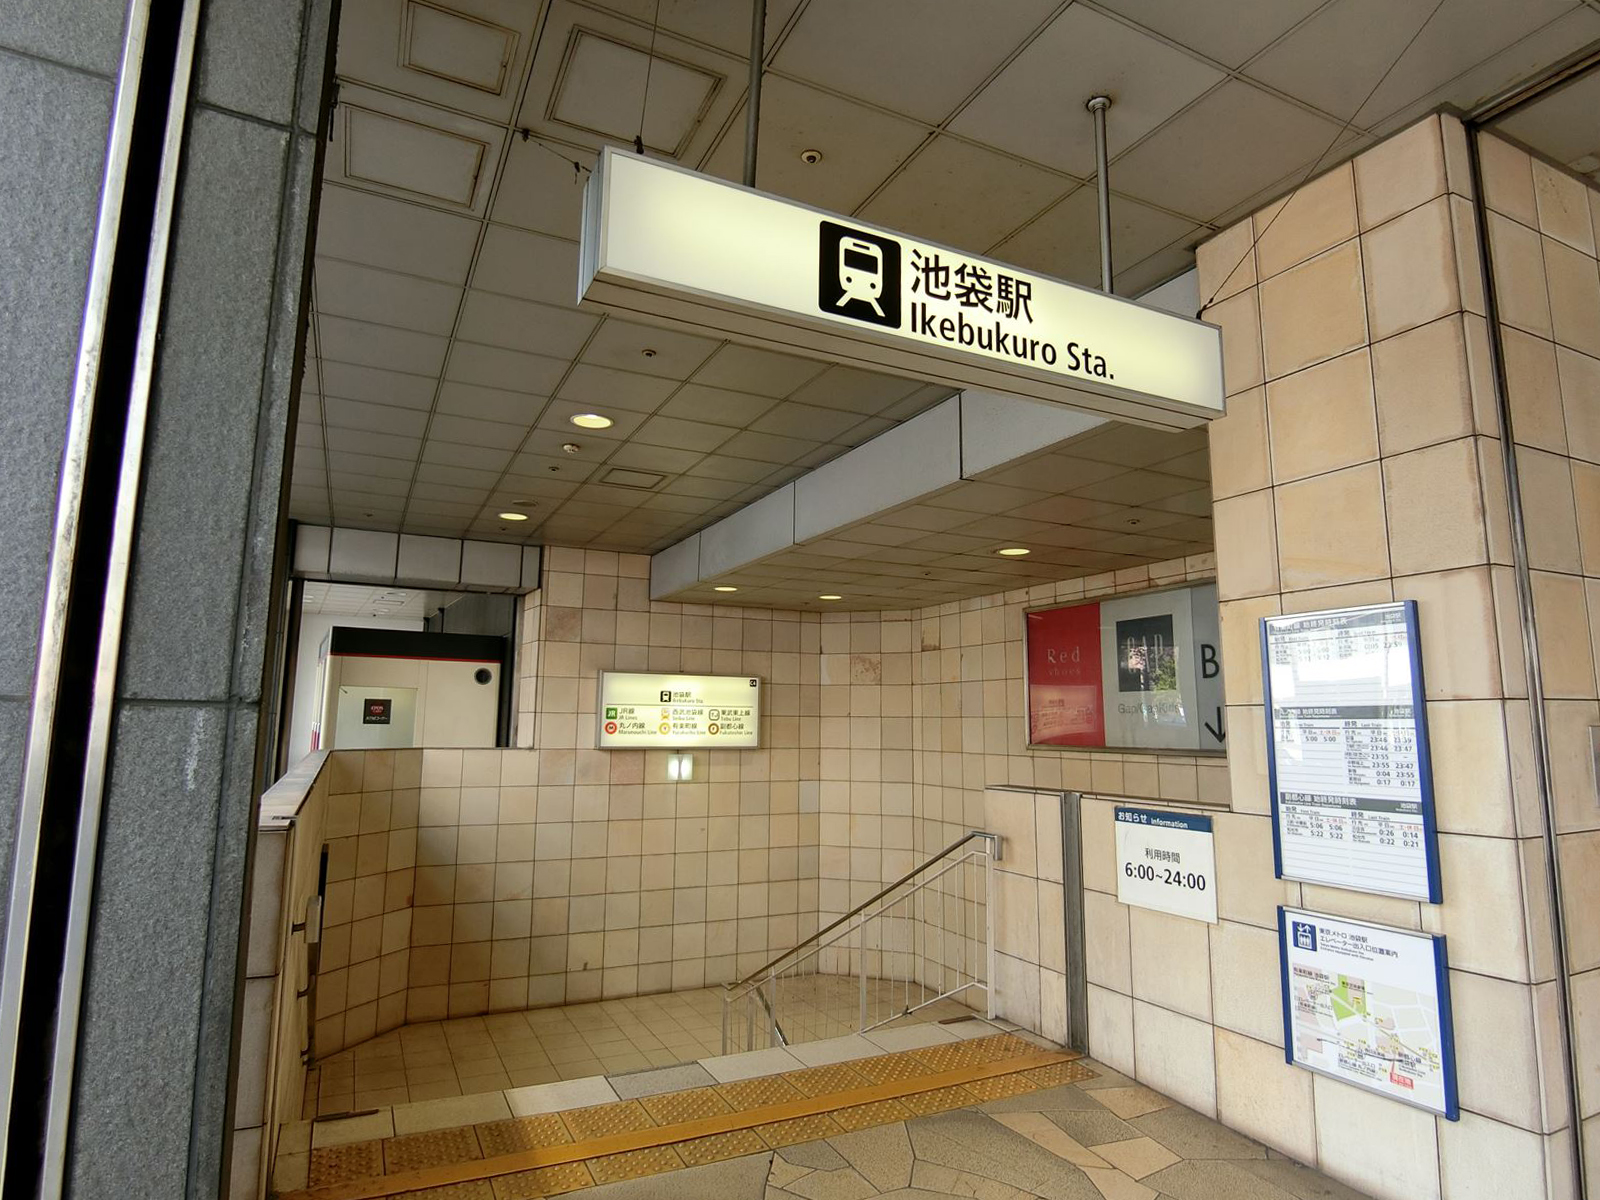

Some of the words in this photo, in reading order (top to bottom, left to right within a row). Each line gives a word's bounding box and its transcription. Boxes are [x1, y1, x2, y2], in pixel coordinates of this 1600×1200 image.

[910, 248, 1034, 323] 池袋駅
[911, 302, 1058, 366] Ikebukuro
[1067, 342, 1116, 380] Sta.
[1047, 646, 1081, 664] Red
[608, 710, 616, 718] JR
[619, 707, 635, 715] JR線
[721, 709, 751, 717] 東武東上線
[619, 722, 646, 730] 丸ノ内線
[1372, 761, 1390, 769] 23:55
[1395, 762, 1414, 770] 23:47
[1118, 811, 1148, 824] お知らせ
[1151, 817, 1189, 829] Information
[1328, 824, 1343, 832] 5:06
[1329, 832, 1344, 840] 5:22
[1378, 829, 1395, 837] 0:26
[1402, 831, 1419, 839] 0:14
[1379, 838, 1395, 846] 0:22
[1403, 839, 1419, 847] 0:21
[1145, 847, 1181, 864] 利用時間
[1319, 928, 1347, 939] 東京メトロ
[1349, 933, 1368, 944] 池袋駅
[1320, 935, 1399, 959] エレベーター出入口位置案内
